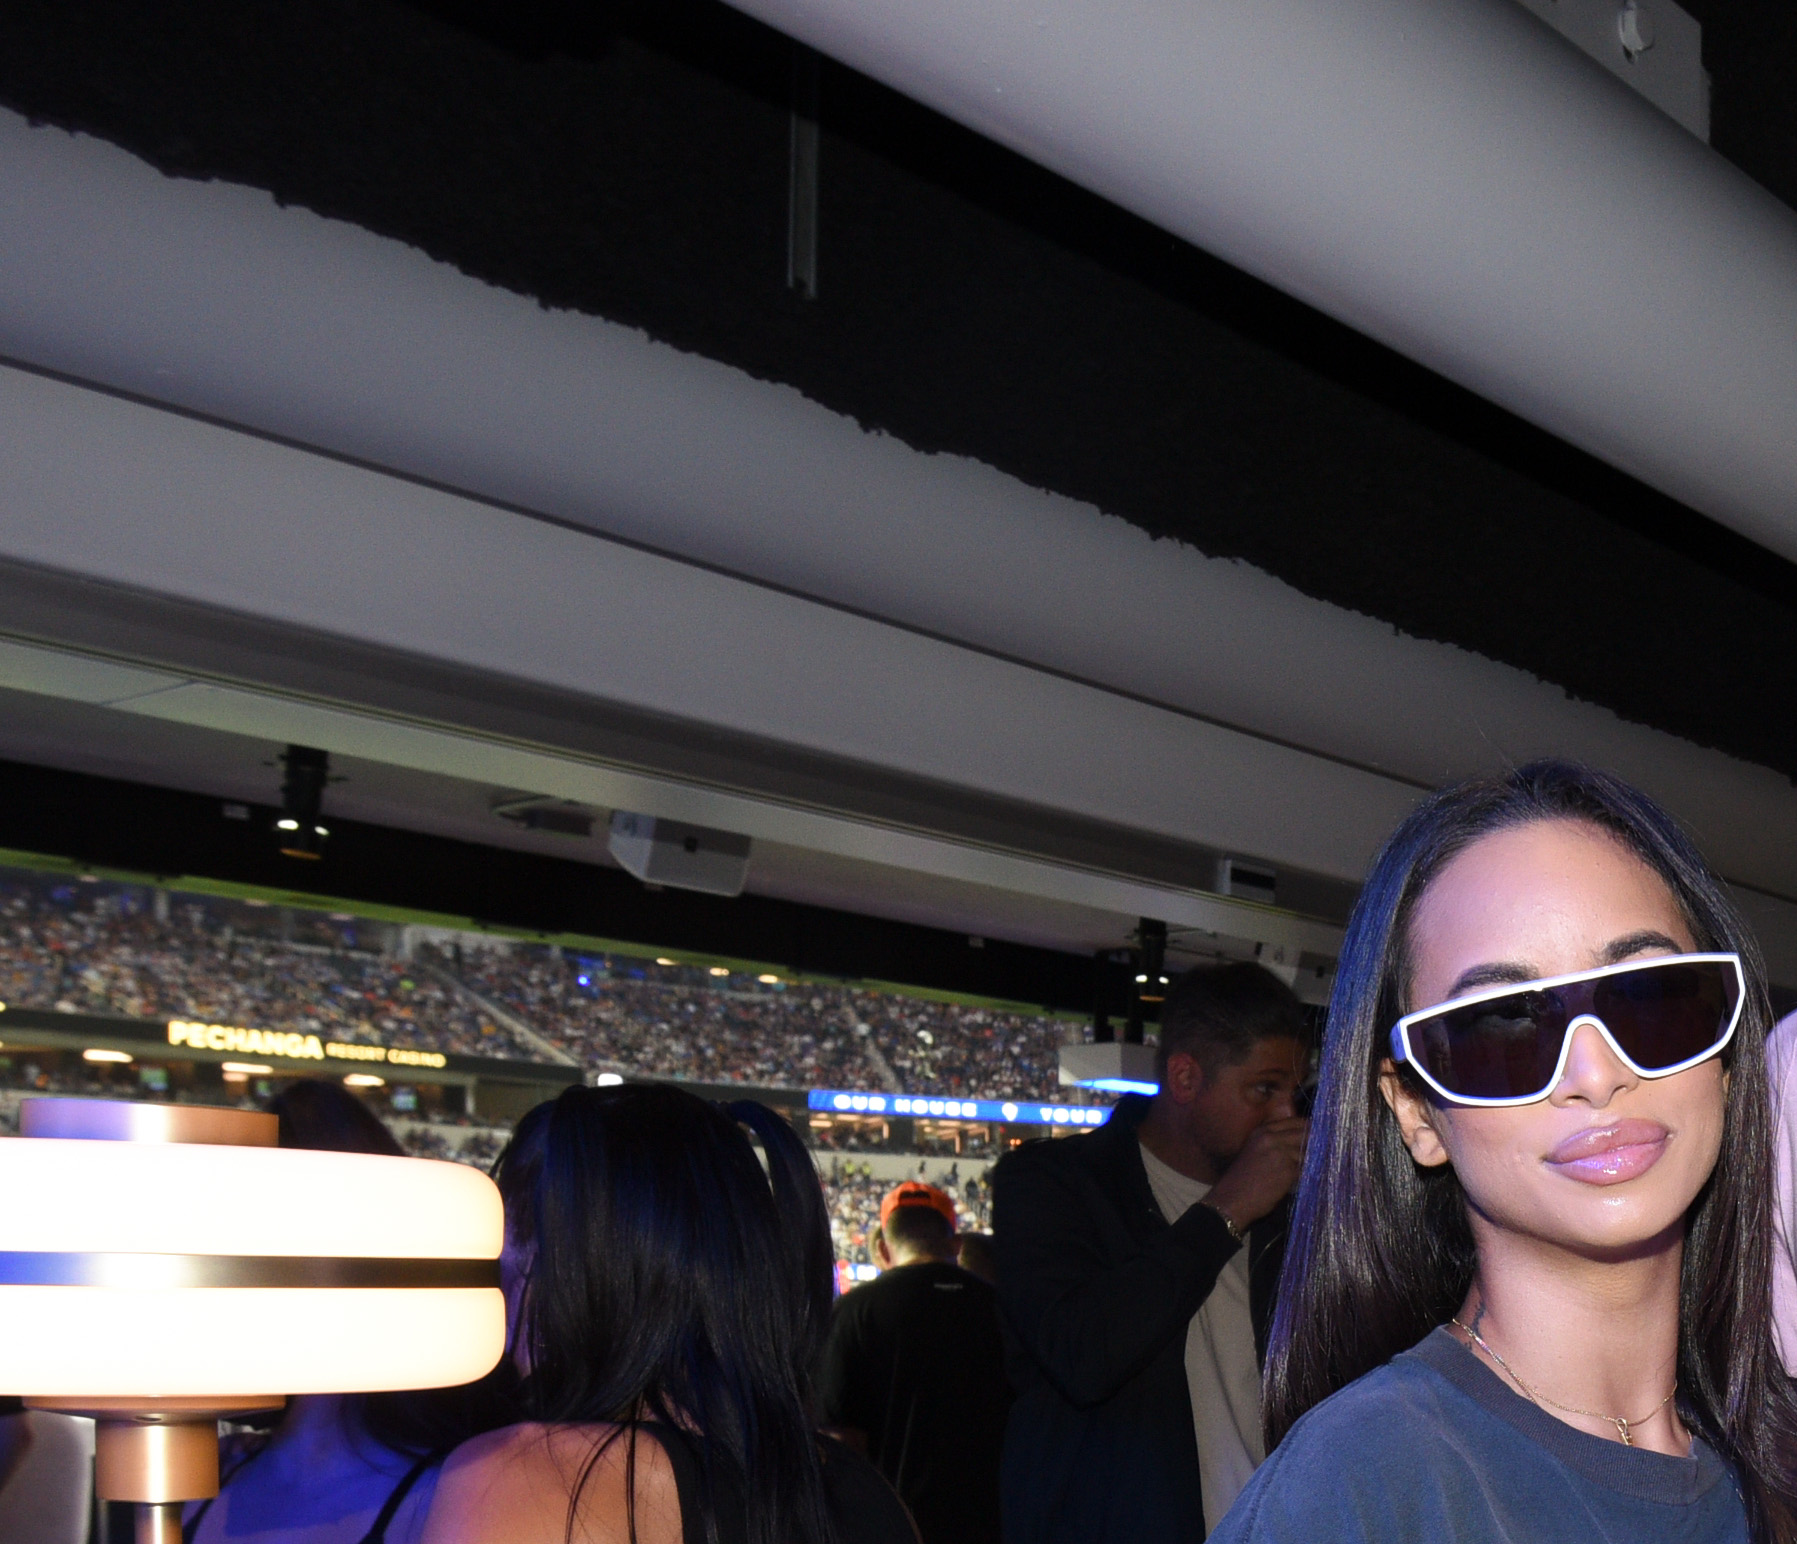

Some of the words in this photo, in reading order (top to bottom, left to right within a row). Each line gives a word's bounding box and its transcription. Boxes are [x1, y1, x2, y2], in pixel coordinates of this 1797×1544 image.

[168, 1020, 324, 1060] PECHANGA
[325, 1042, 386, 1062] RESORT
[387, 1049, 446, 1068] CASINO
[833, 1094, 886, 1112] OUR
[895, 1098, 977, 1117] HOUSE
[1040, 1107, 1103, 1125] YOUR
